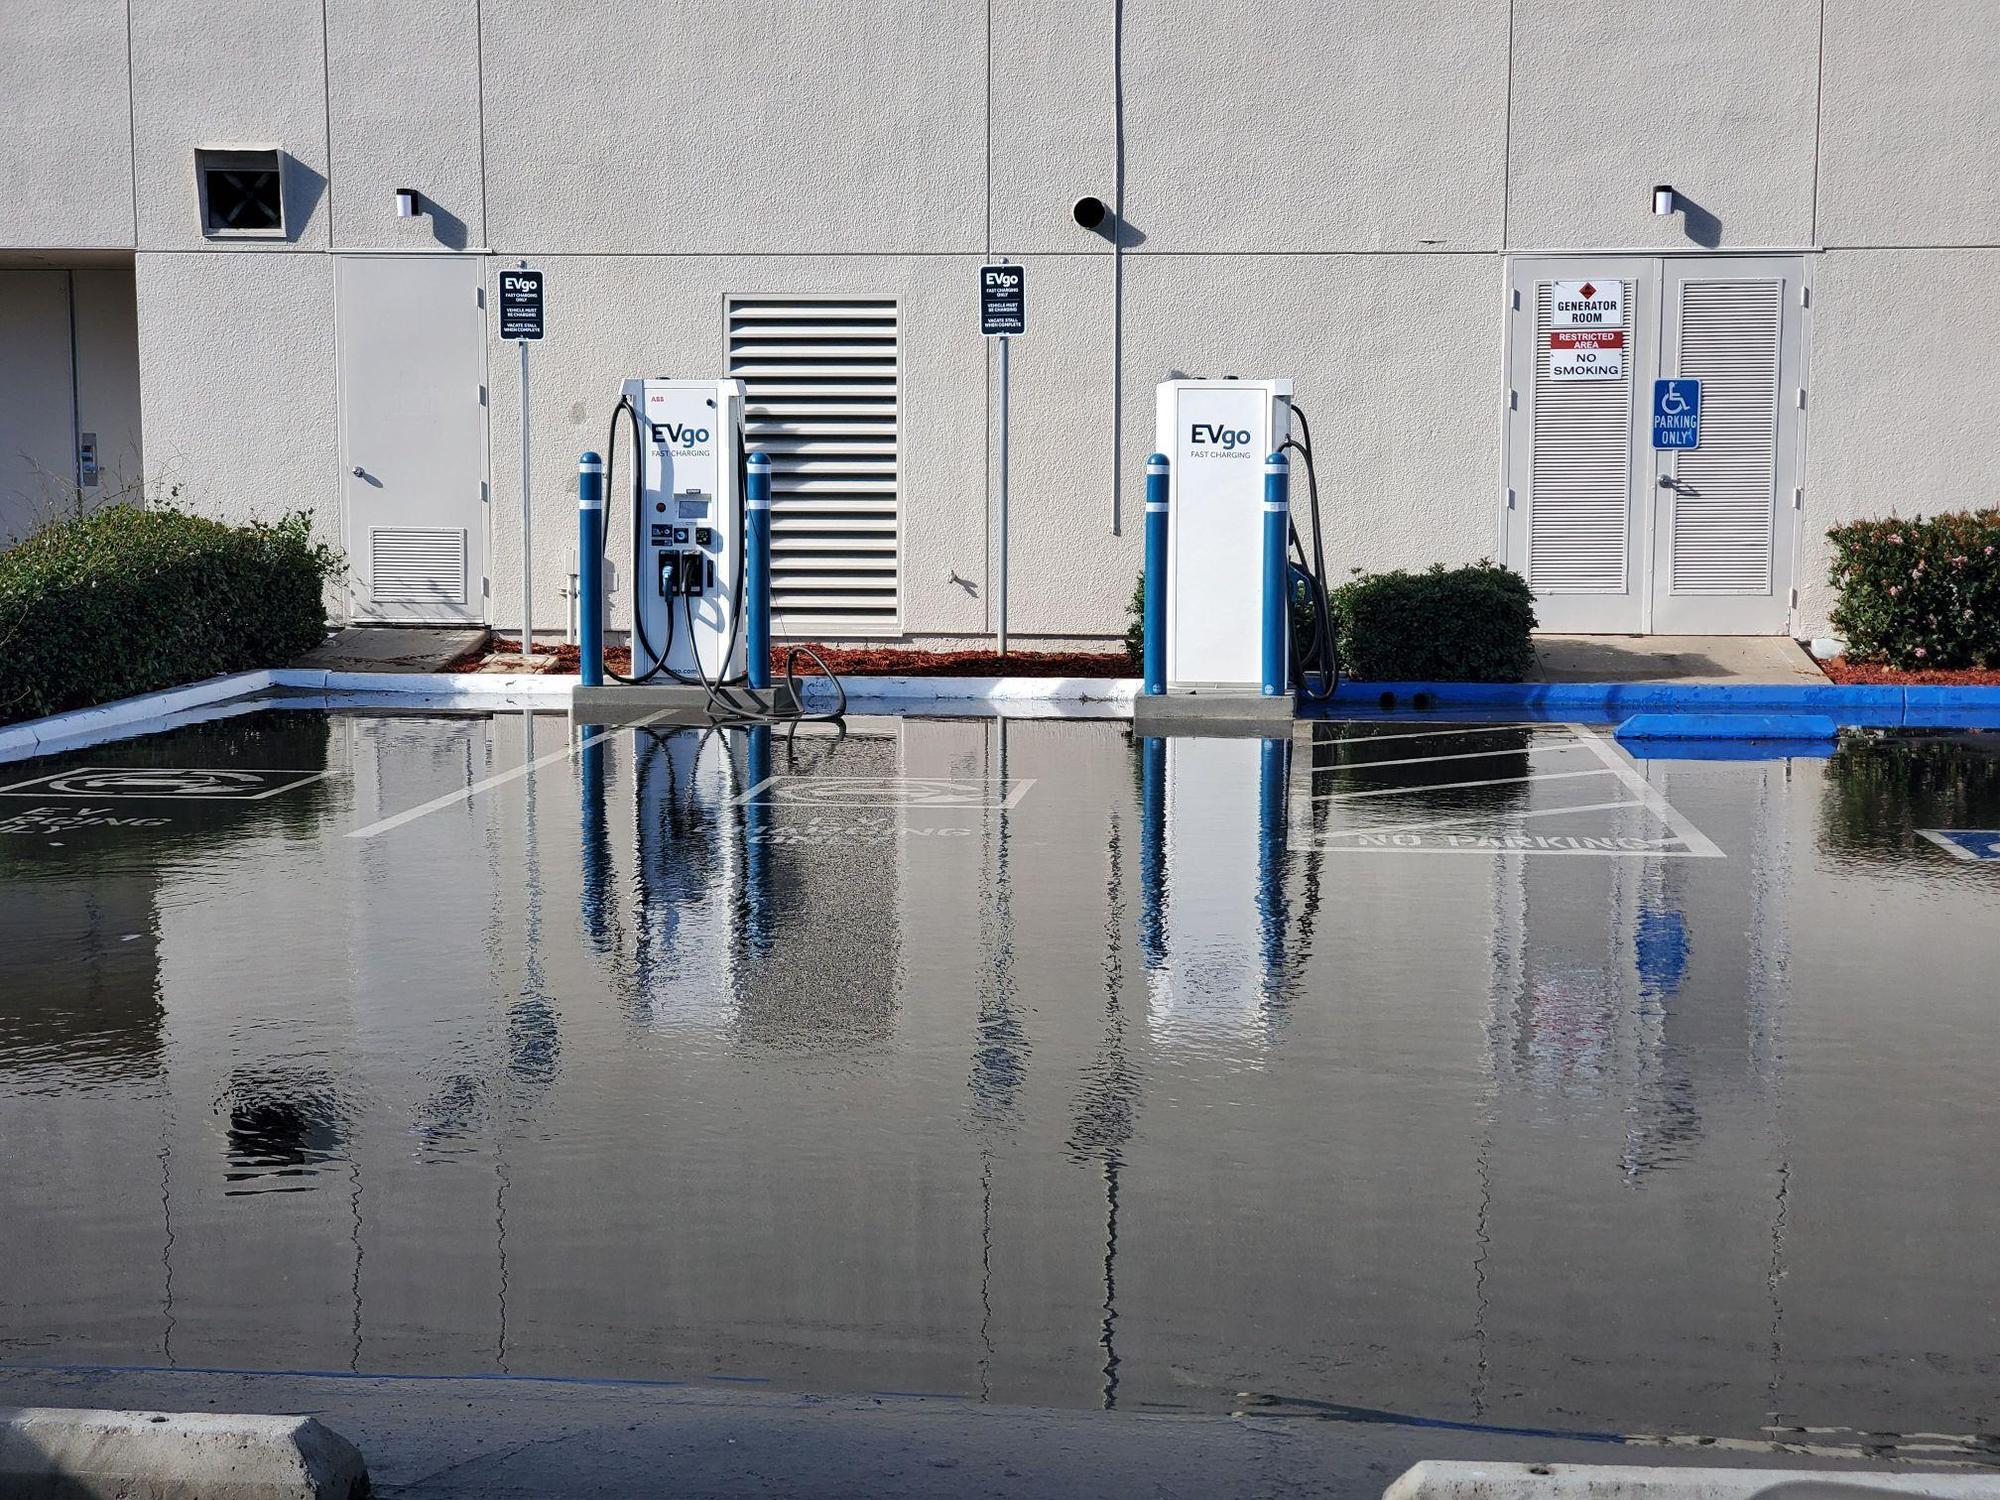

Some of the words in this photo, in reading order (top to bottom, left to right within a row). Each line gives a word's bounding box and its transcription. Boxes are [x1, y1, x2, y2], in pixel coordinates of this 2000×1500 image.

[505, 278, 537, 292] EVgo
[986, 273, 1018, 287] EVgo
[1558, 301, 1617, 312] GENERATOR
[1572, 313, 1602, 323] ROOM
[1576, 354, 1596, 362] NO
[1554, 366, 1618, 375] SMOKING
[1655, 415, 1696, 428] PARKING
[652, 424, 709, 448] EVgo
[1192, 424, 1250, 450] EVgo
[1662, 431, 1687, 444] ONLY
[22, 807, 114, 815] EV
[1359, 835, 1421, 846] NO
[1447, 836, 1652, 849] PARKING
